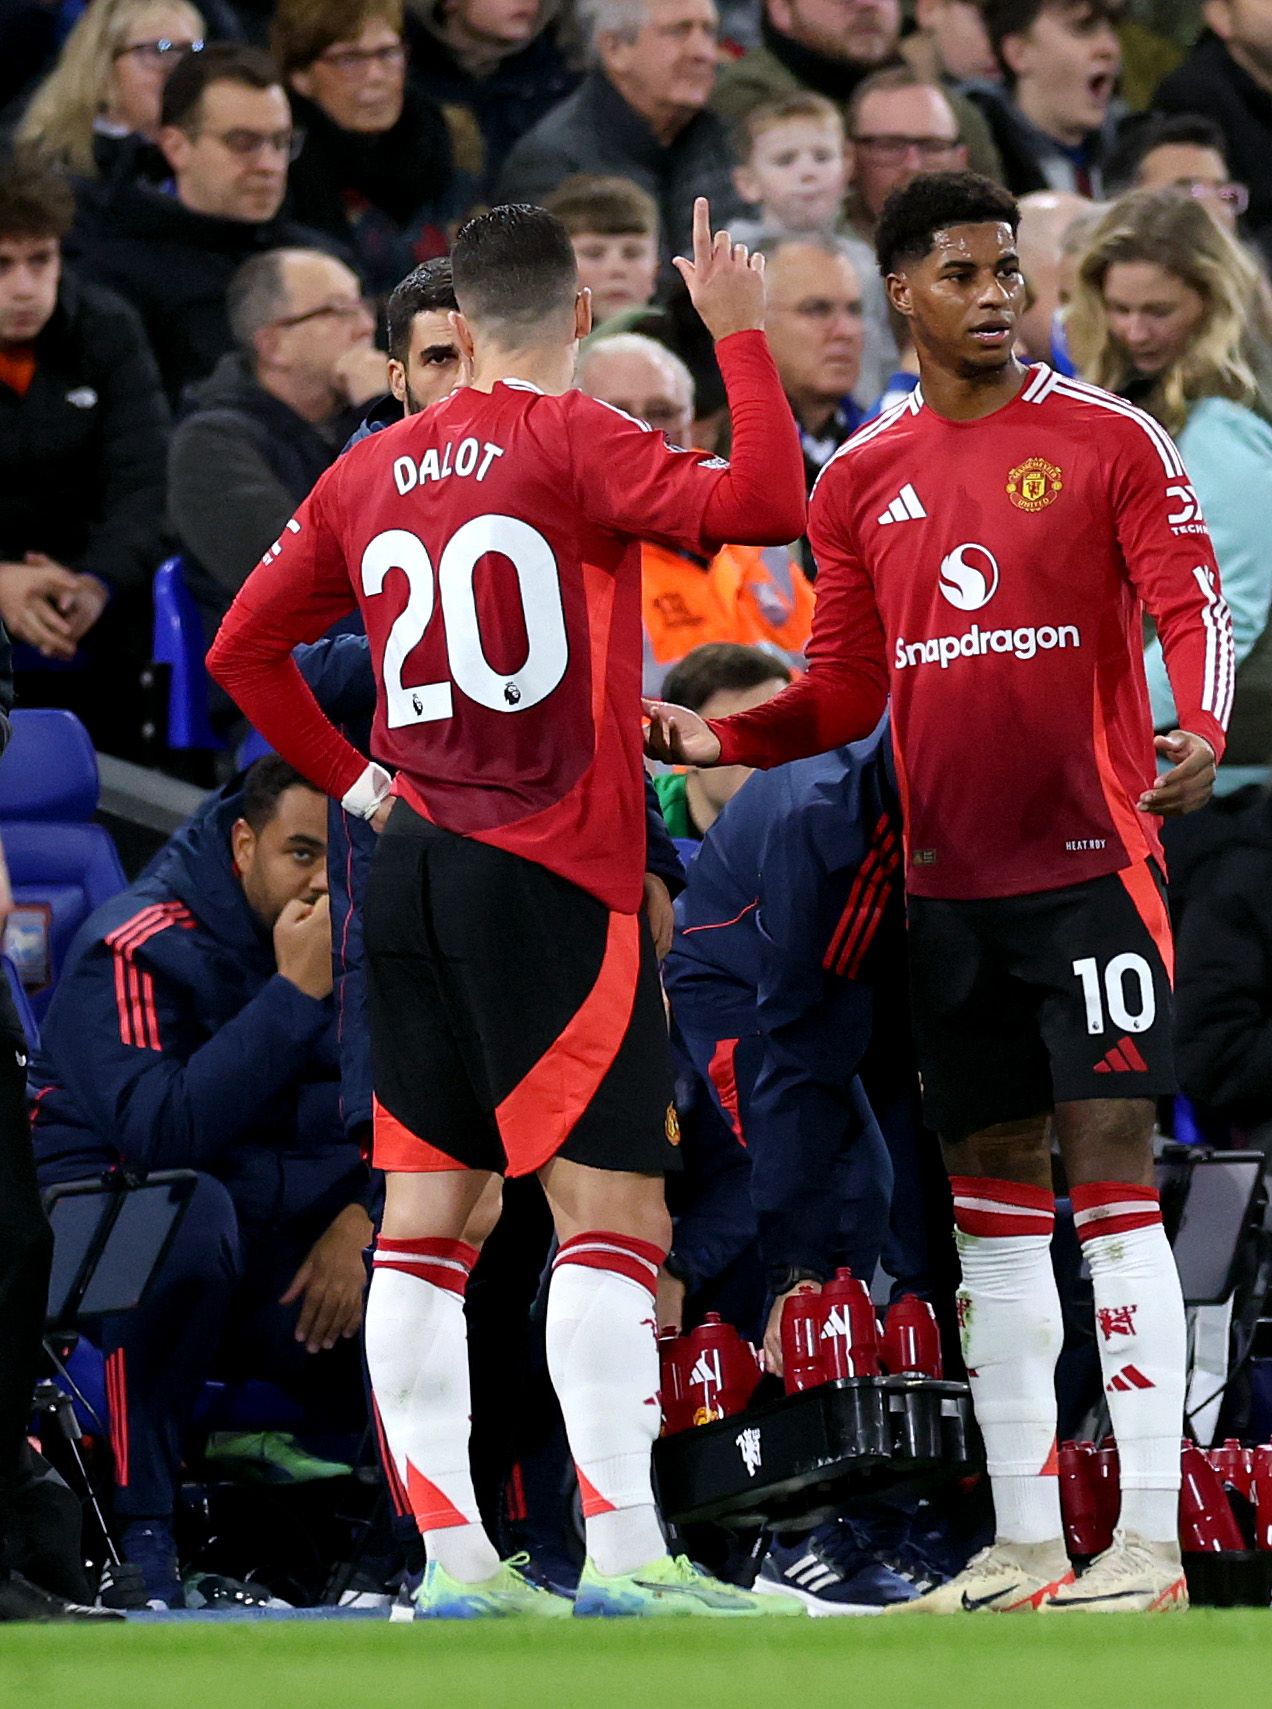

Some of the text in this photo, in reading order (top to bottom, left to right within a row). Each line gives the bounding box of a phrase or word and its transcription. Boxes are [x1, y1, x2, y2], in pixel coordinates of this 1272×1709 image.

[393, 437, 504, 496] DALOT
[361, 513, 569, 729] 20
[894, 623, 1081, 669] Snapdragon
[1072, 952, 1156, 1034] 10
